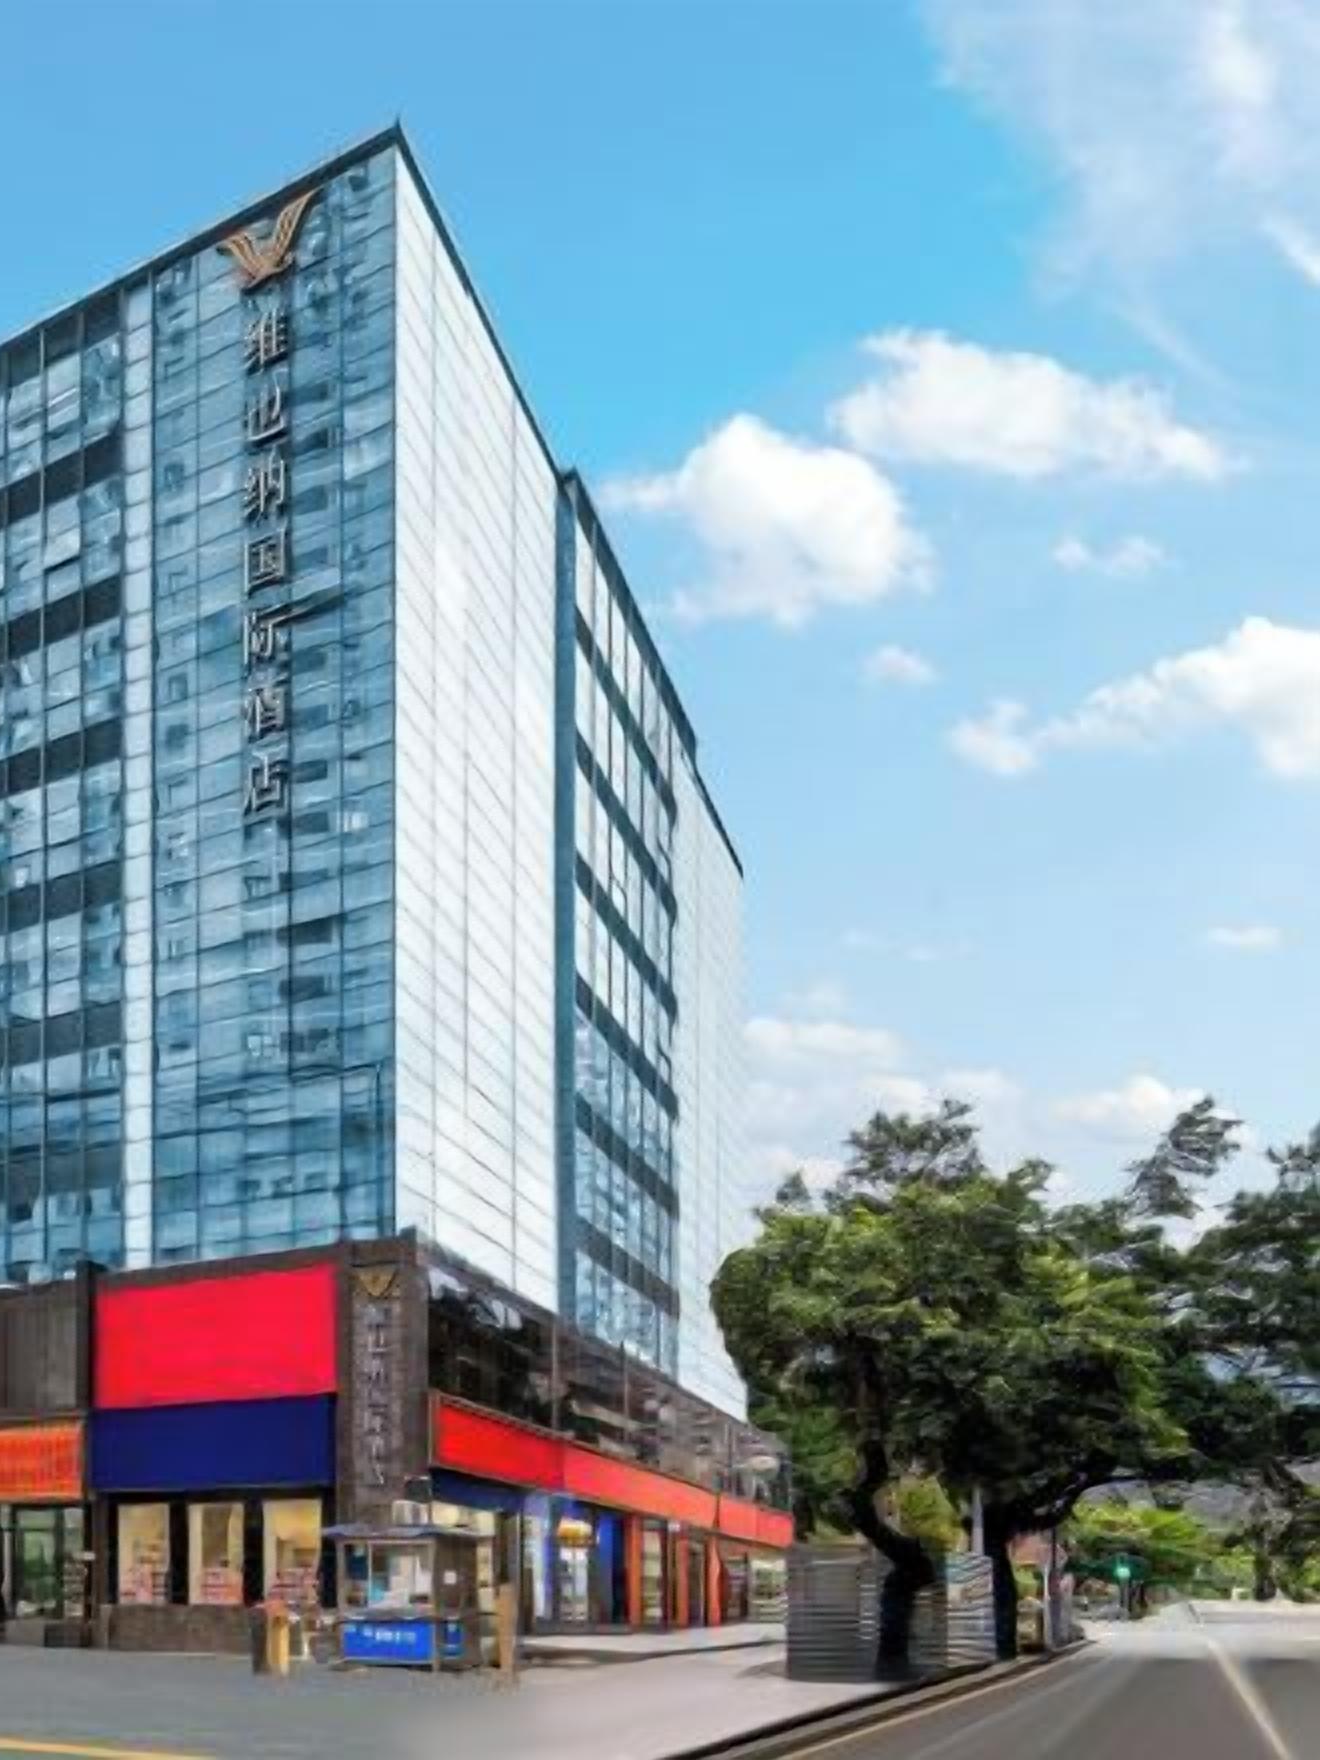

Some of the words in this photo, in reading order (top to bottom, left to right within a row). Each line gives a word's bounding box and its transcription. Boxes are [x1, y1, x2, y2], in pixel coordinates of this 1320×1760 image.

[243, 308, 289, 816] 维也纳国际酒店
